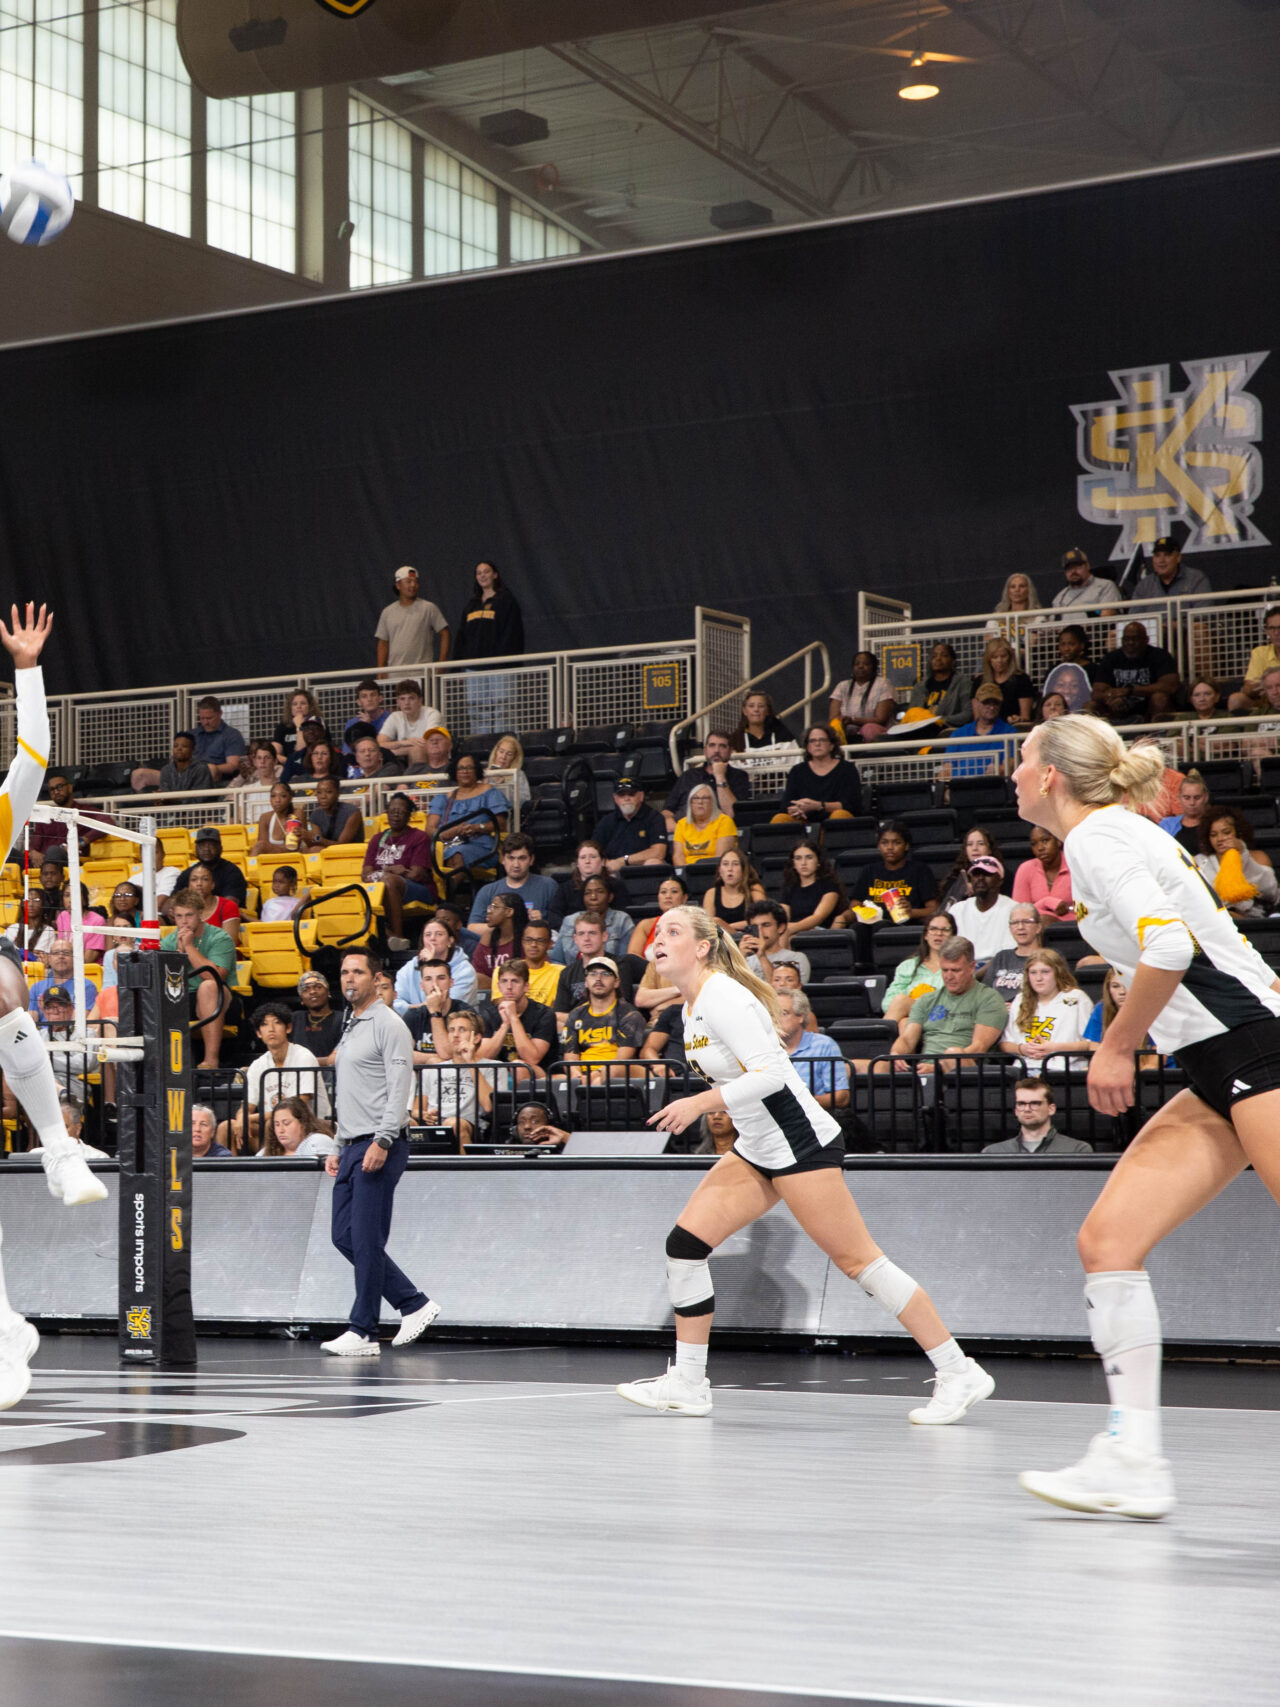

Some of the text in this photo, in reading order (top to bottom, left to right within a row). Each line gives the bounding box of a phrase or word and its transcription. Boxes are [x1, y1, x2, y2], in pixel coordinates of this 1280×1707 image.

[891, 656, 912, 669] 104
[651, 675, 672, 688] 105
[579, 1026, 613, 1044] KSU
[133, 1193, 145, 1293] sports imports
